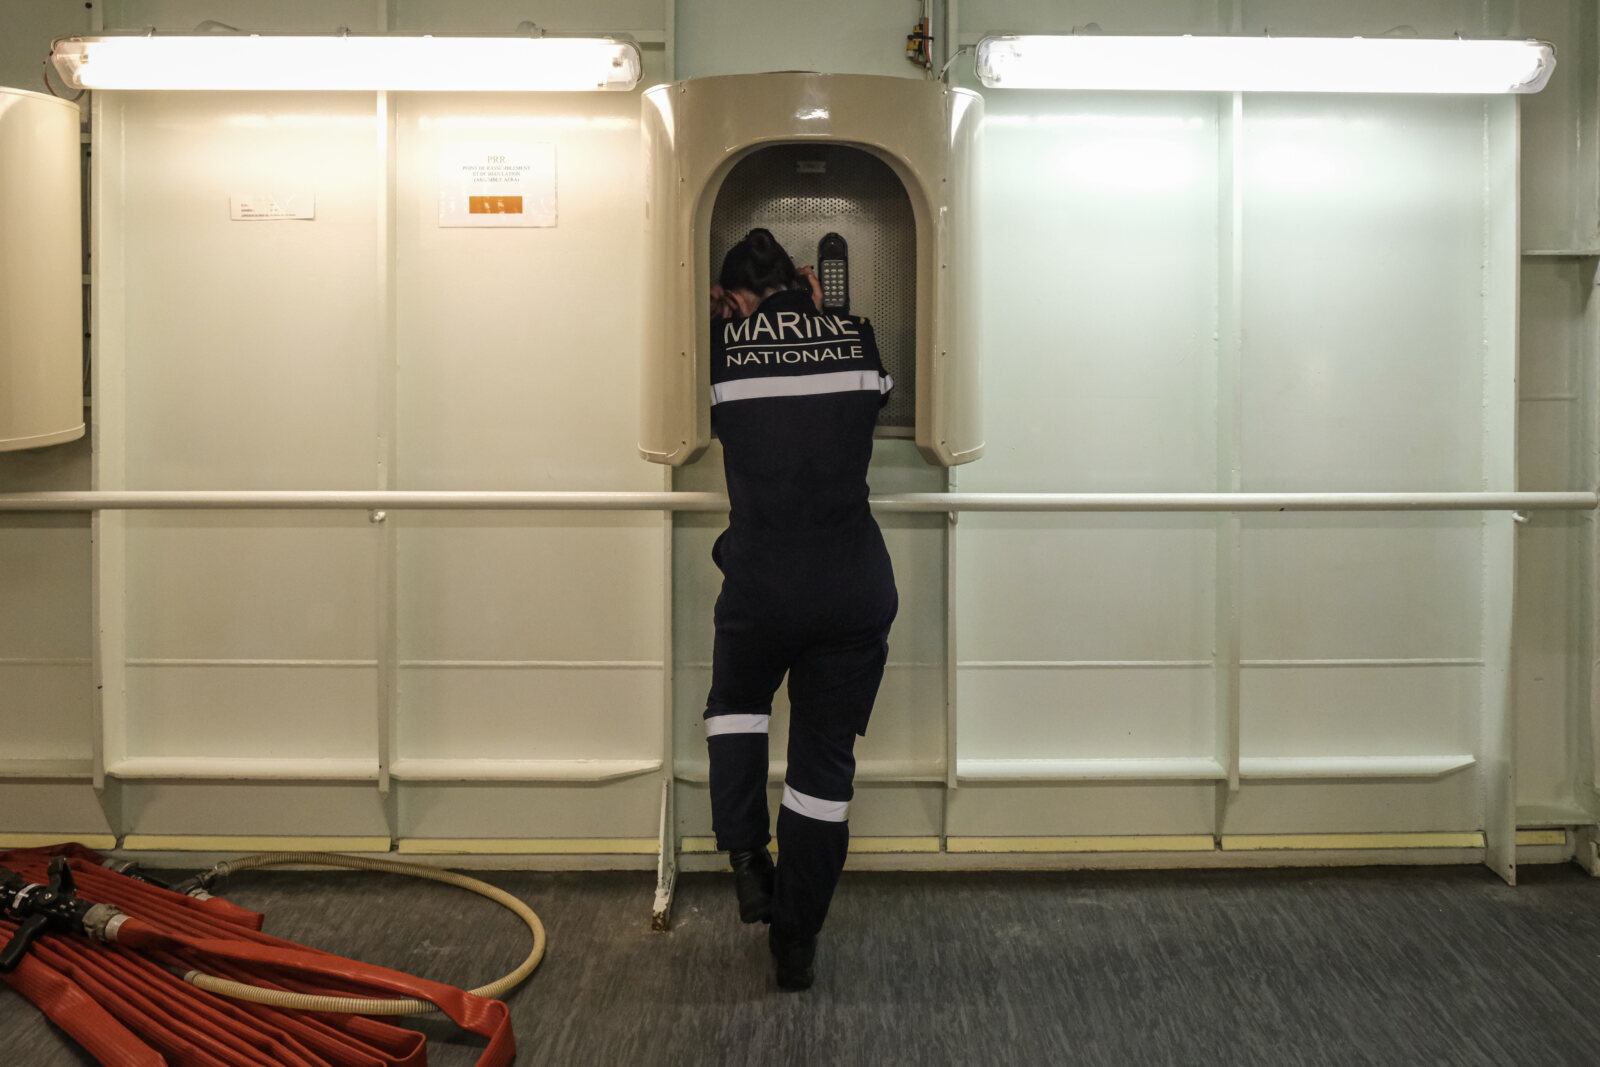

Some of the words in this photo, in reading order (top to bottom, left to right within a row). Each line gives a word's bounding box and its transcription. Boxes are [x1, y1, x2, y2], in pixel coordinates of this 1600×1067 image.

[487, 155, 506, 164] PRR
[724, 311, 860, 344] MARINE
[726, 345, 864, 368] NATIONALE
